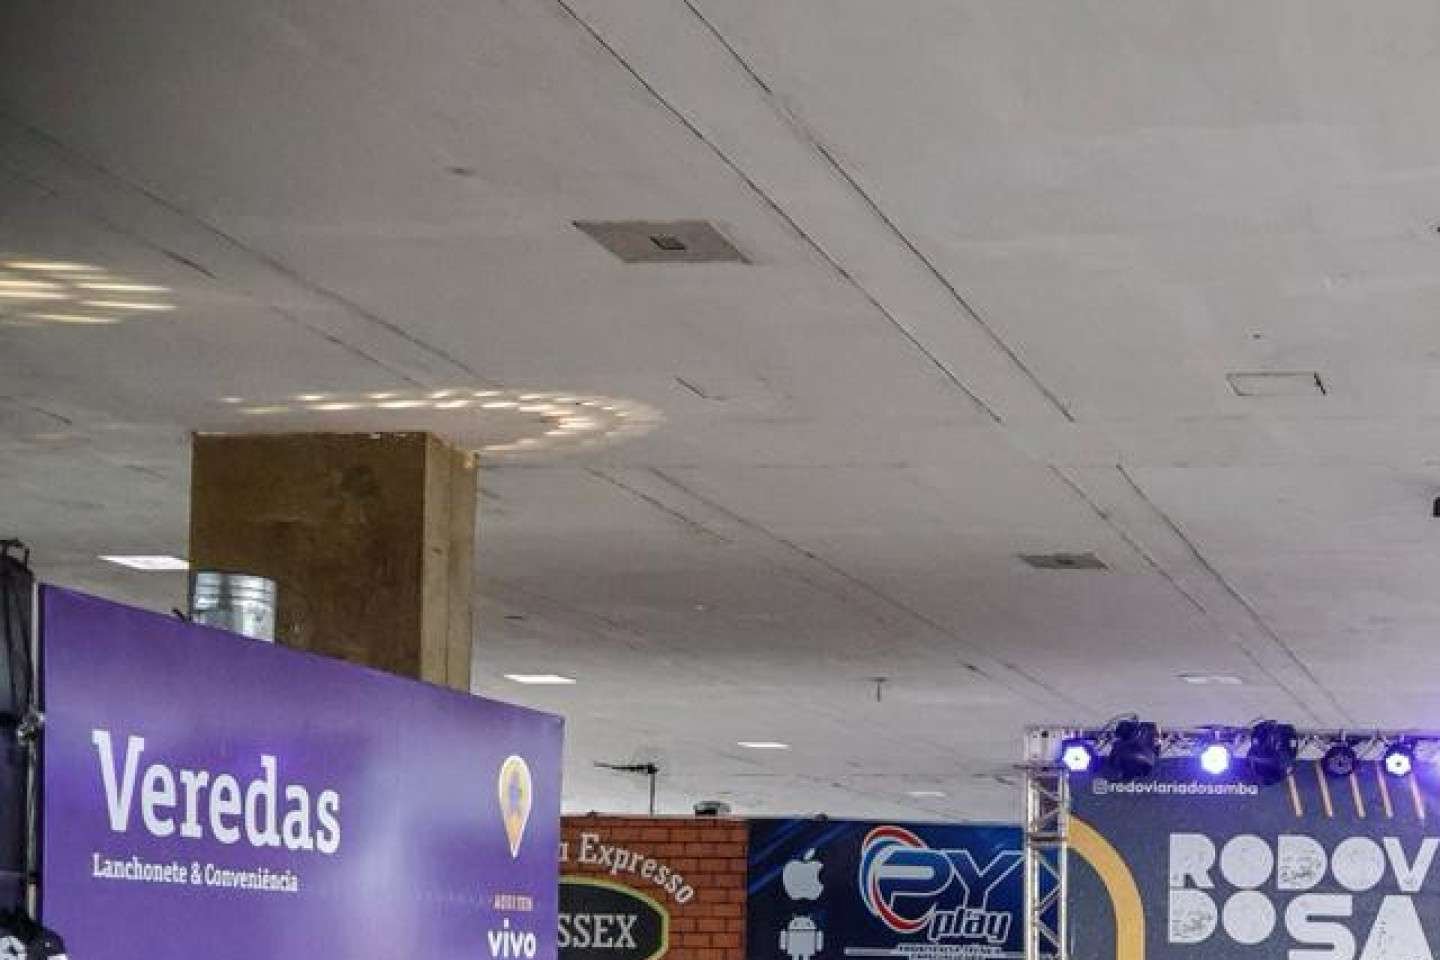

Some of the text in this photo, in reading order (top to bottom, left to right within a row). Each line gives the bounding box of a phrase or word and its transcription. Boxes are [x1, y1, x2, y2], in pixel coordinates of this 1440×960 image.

[91, 729, 341, 854] Veredas
[93, 852, 298, 893] Lanchonete & Conveniência
[577, 834, 695, 903] Expresso
[487, 917, 537, 959] vivo
[928, 903, 1012, 944] play
[1169, 888, 1277, 945] DO
